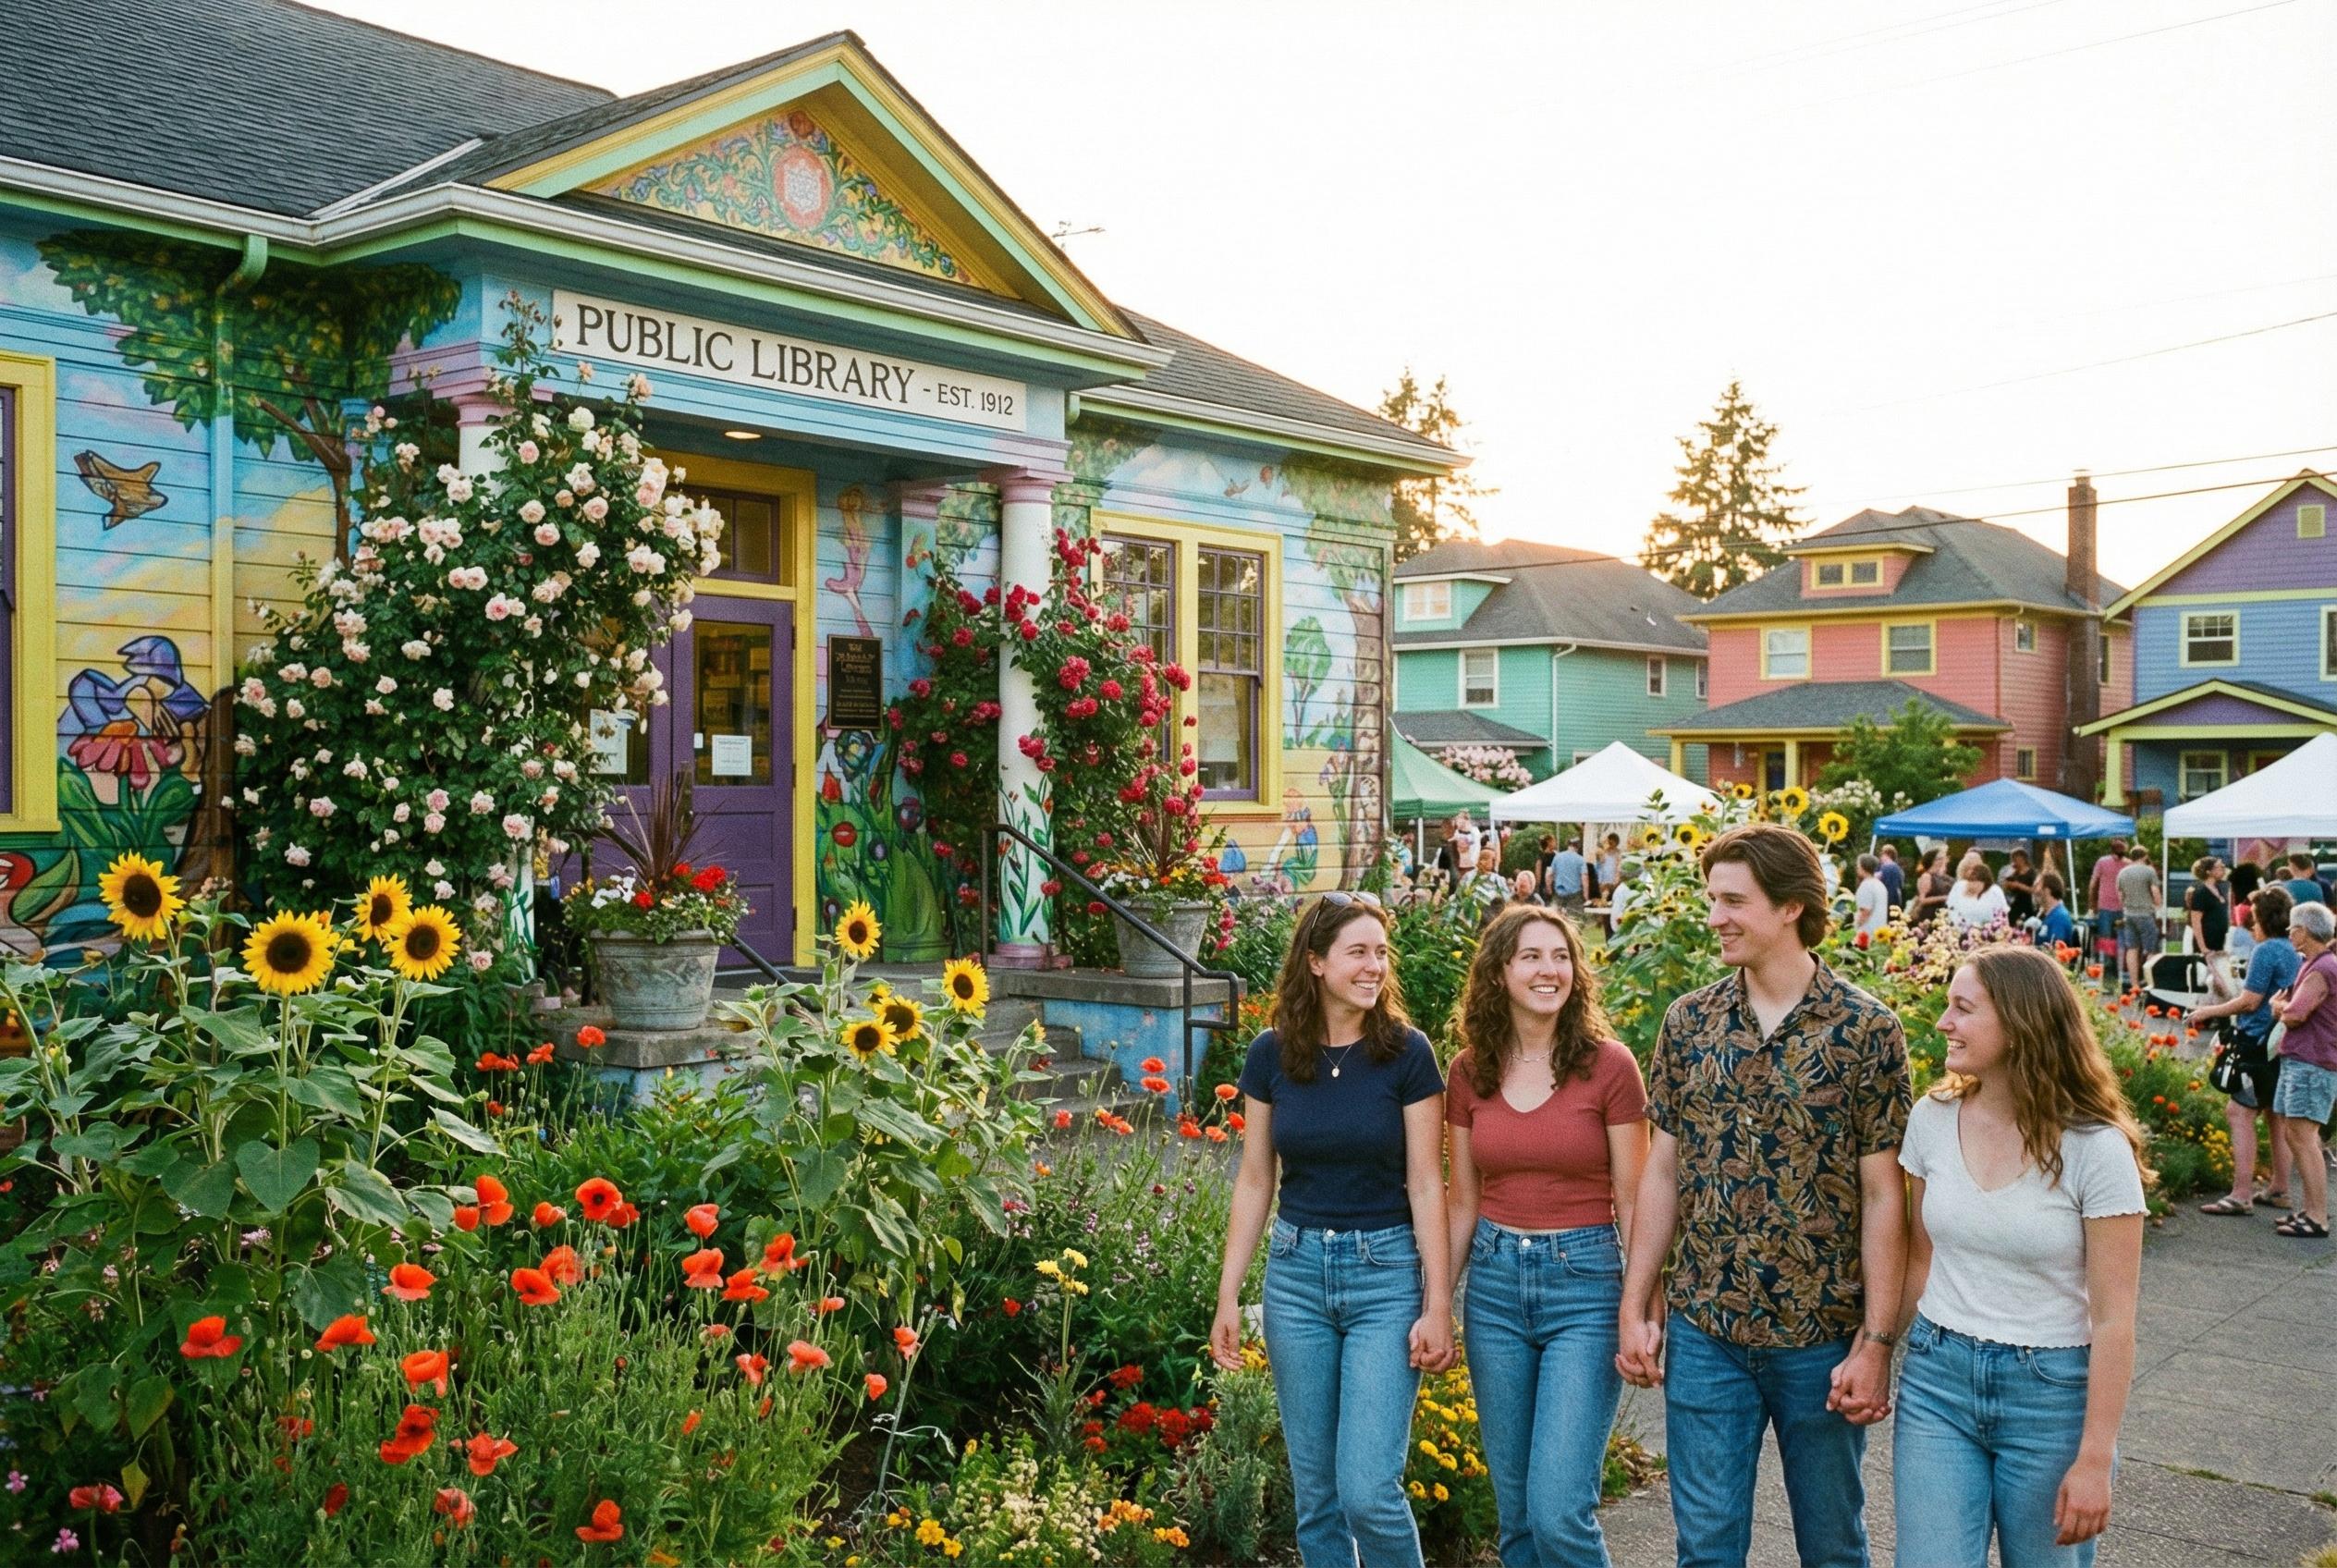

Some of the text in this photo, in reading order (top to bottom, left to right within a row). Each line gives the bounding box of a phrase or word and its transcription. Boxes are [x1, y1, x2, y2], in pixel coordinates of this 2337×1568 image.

[576, 303, 733, 372] PUBLIC
[751, 338, 915, 404] LIBRARY
[937, 382, 974, 409] EST.
[981, 391, 1013, 416] 1912
